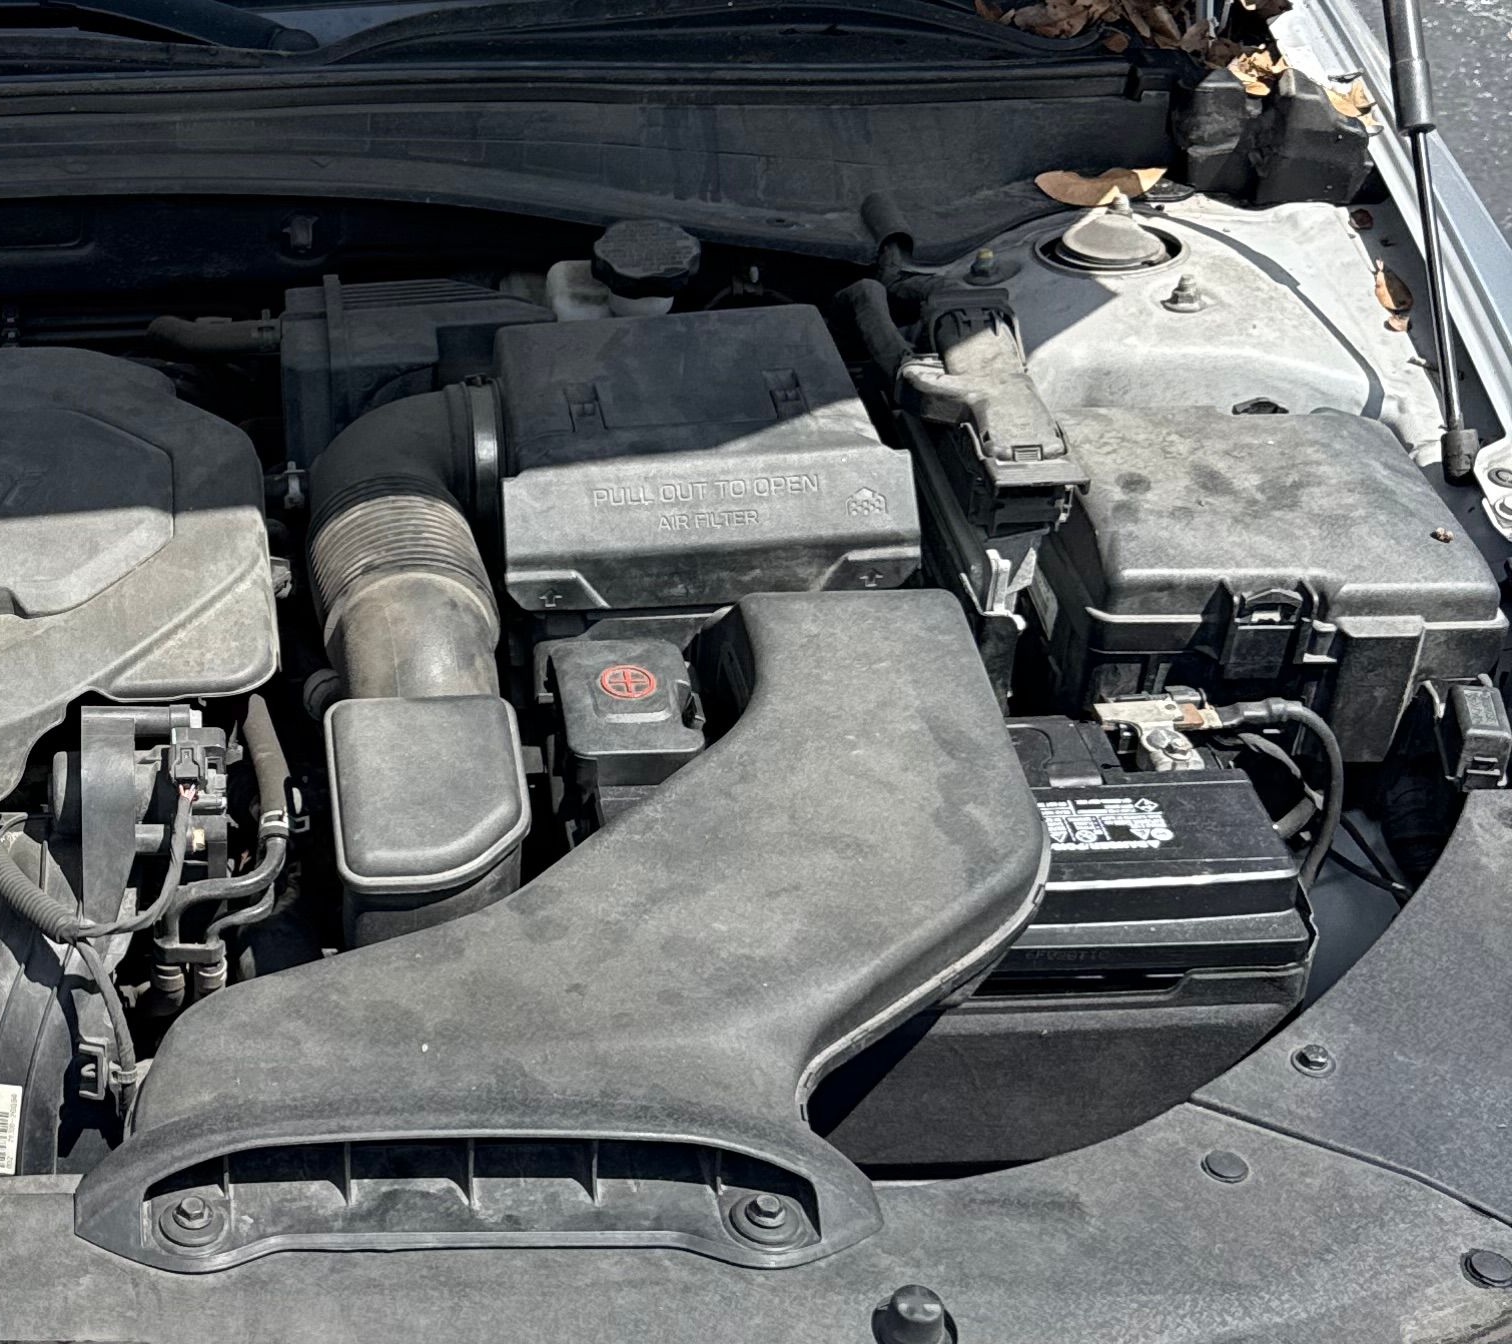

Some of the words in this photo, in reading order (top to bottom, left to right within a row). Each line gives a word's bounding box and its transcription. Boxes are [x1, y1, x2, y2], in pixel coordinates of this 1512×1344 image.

[592, 486, 654, 507] PULL
[658, 481, 708, 503] OUT
[714, 478, 747, 498] TO
[753, 473, 819, 496] OPEN
[657, 514, 690, 531] AIR
[694, 509, 760, 529] FILTER
